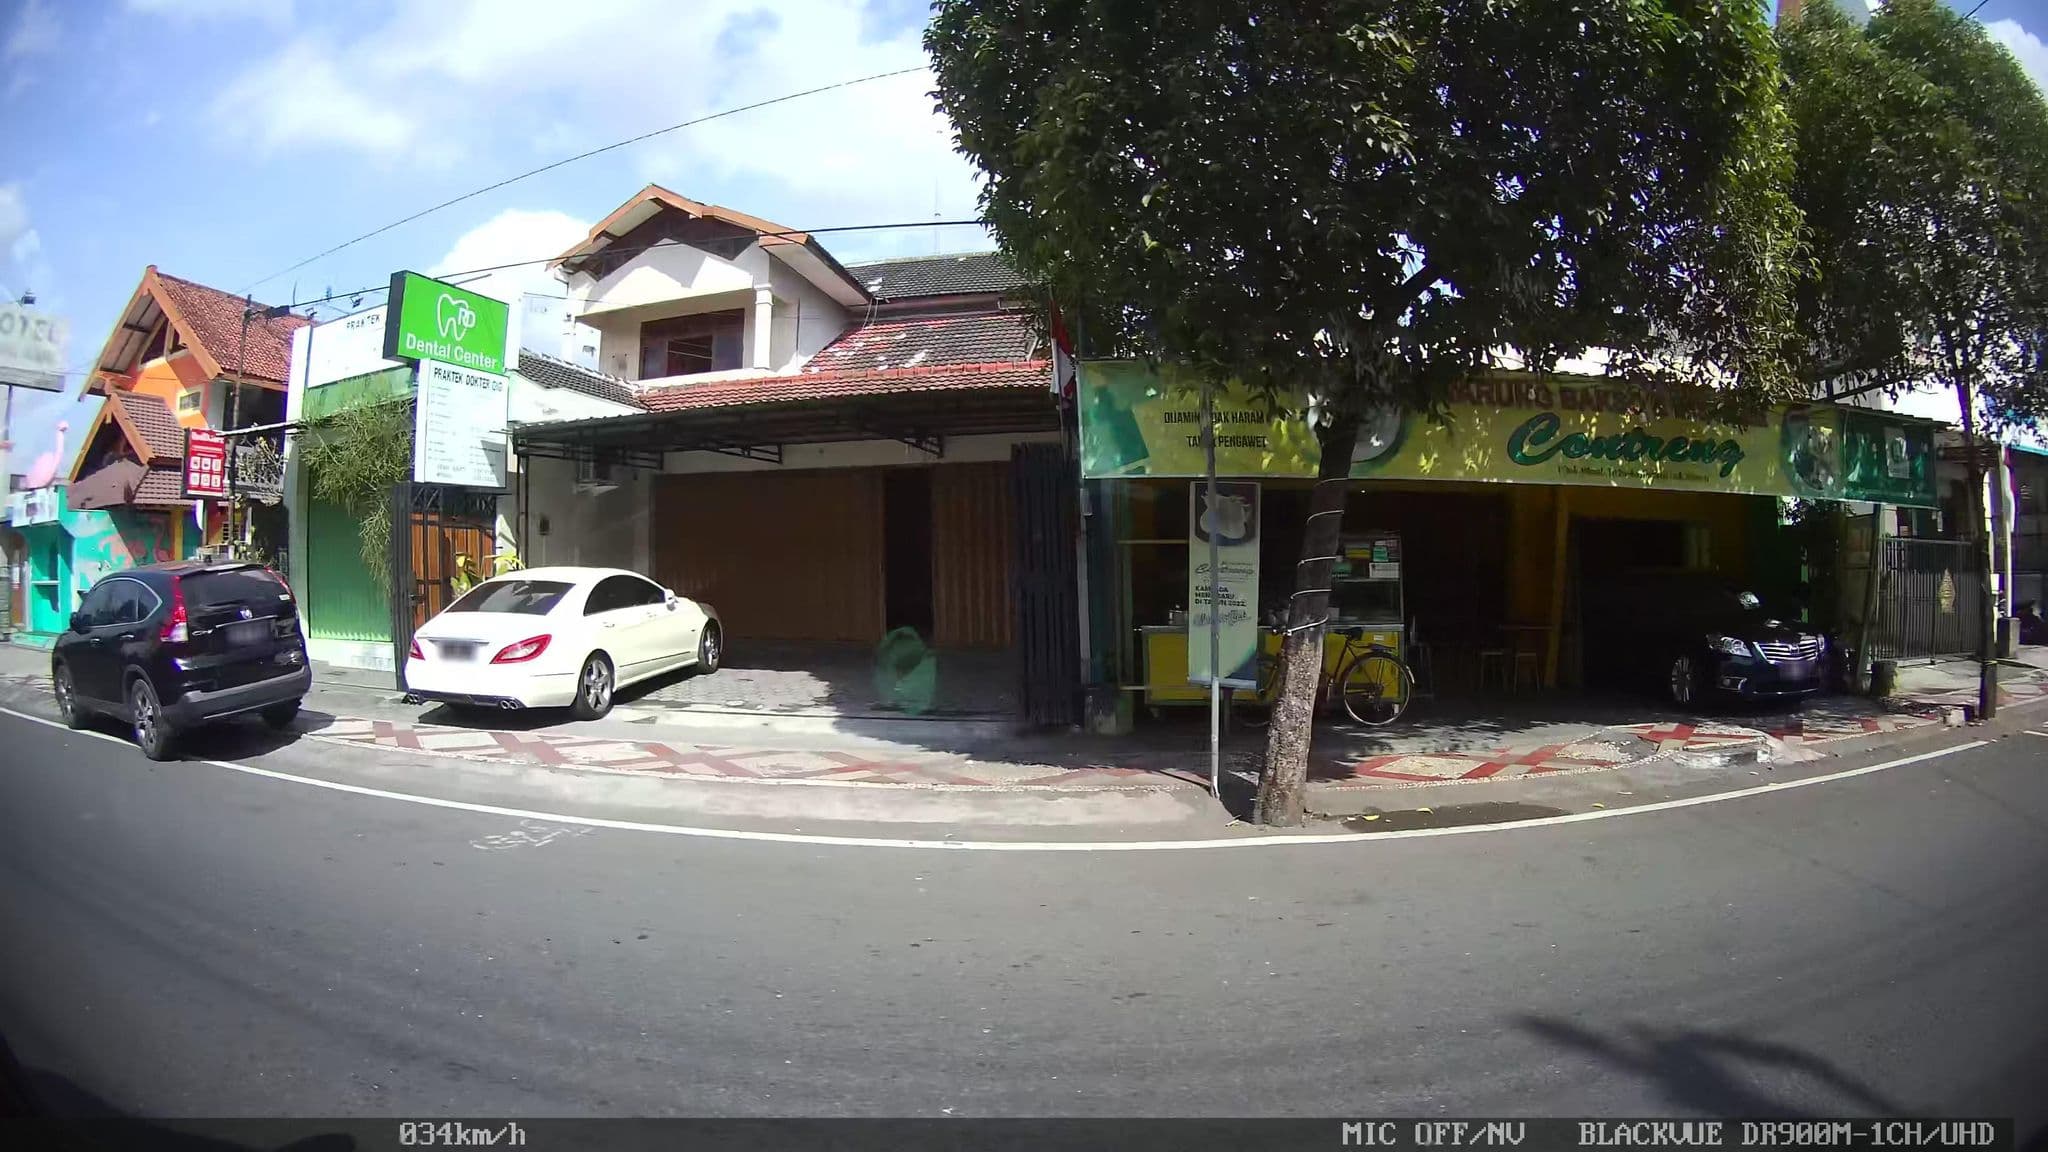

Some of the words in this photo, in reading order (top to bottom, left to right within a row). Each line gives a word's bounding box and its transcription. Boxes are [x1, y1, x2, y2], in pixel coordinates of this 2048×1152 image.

[406, 333, 452, 358] Dental
[453, 346, 497, 369] Center
[433, 367, 464, 383] PRAKTEK
[465, 375, 491, 389] DOKTER
[1231, 411, 1265, 424] HARAM
[1218, 435, 1266, 448] PENGAWET
[1507, 411, 1746, 478] Contreng
